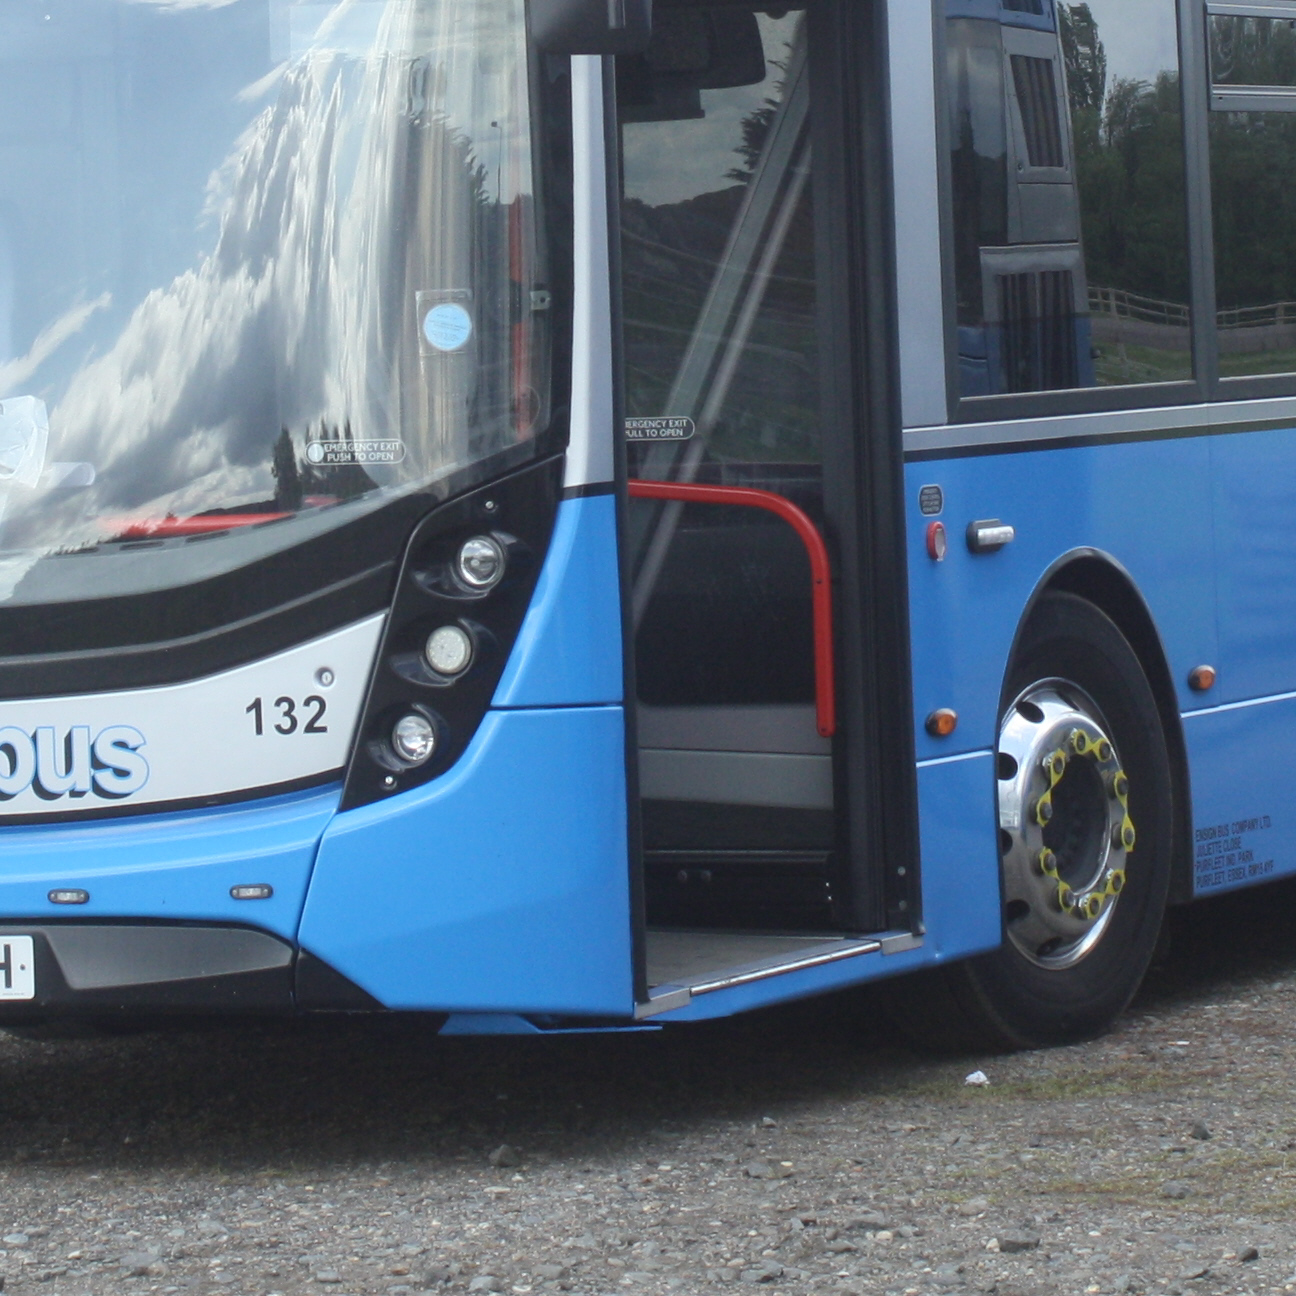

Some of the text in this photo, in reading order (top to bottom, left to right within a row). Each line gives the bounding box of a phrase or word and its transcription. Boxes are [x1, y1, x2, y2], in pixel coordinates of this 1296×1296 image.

[625, 419, 688, 429] ERGENCY EXIT
[645, 429, 658, 437] TO
[659, 428, 684, 437] OPEN
[324, 442, 399, 452] EMERGENCY EXIT
[327, 452, 394, 462] PUSH TO OPEN
[245, 696, 329, 736] 132
